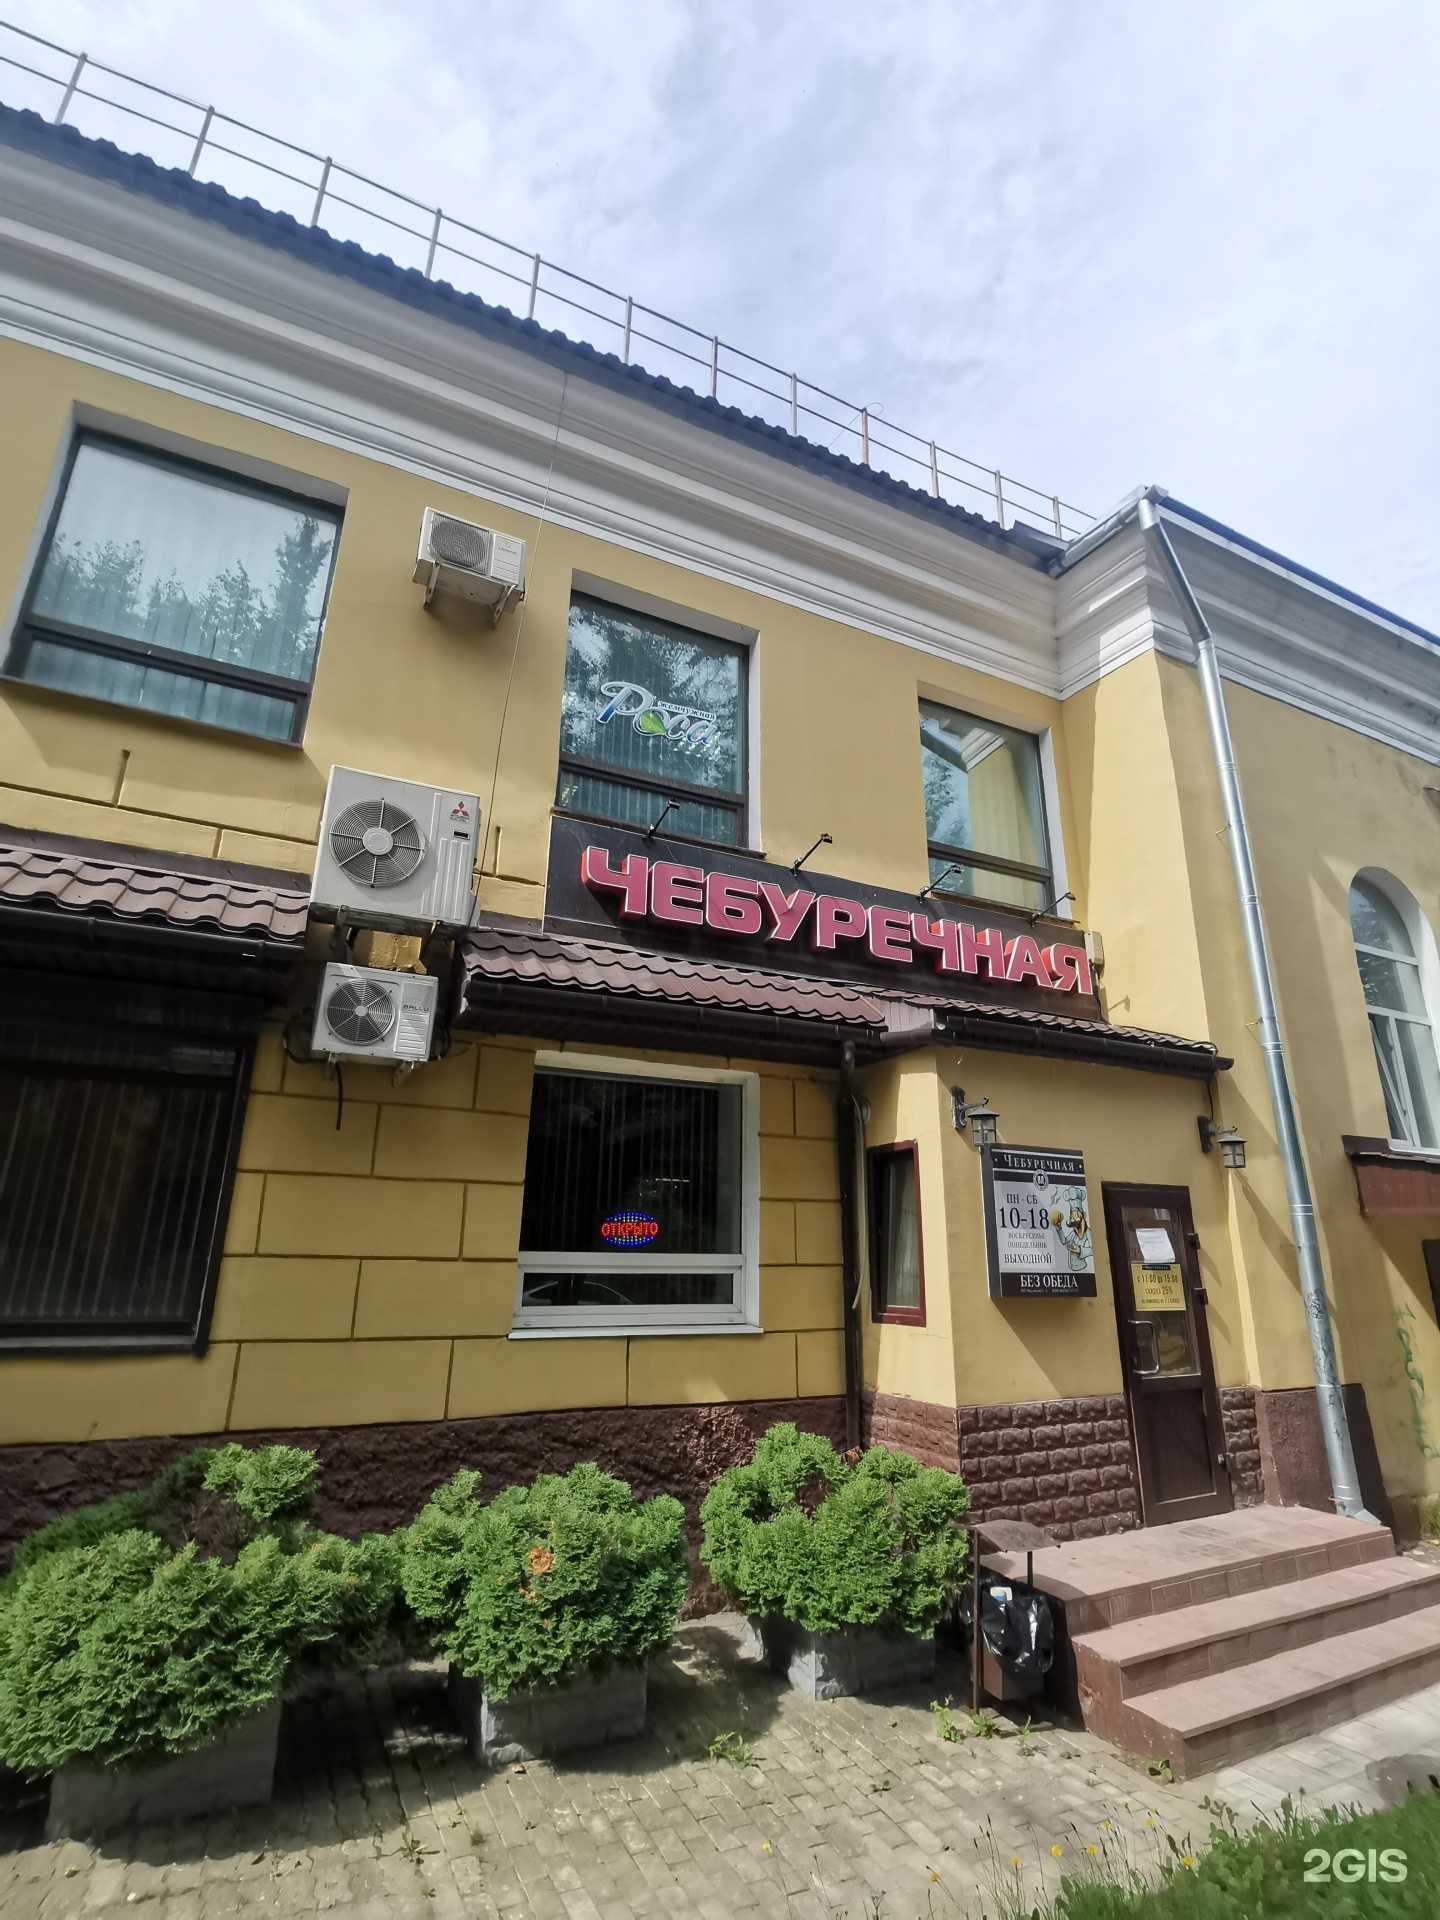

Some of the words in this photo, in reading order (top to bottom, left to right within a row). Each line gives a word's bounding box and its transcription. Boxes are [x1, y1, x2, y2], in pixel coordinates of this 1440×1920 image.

[597, 681, 717, 744] Роса
[579, 845, 1093, 995] ЧЕБУРЕЧНАЯ
[999, 1206, 1050, 1230] 10-18
[601, 1222, 659, 1237] ОТКРЫТО
[1004, 1252, 1053, 1264] ВЫХОДНОЙ
[1020, 1274, 1041, 1288] БЕЗ
[1042, 1274, 1078, 1289] ОБЕДА
